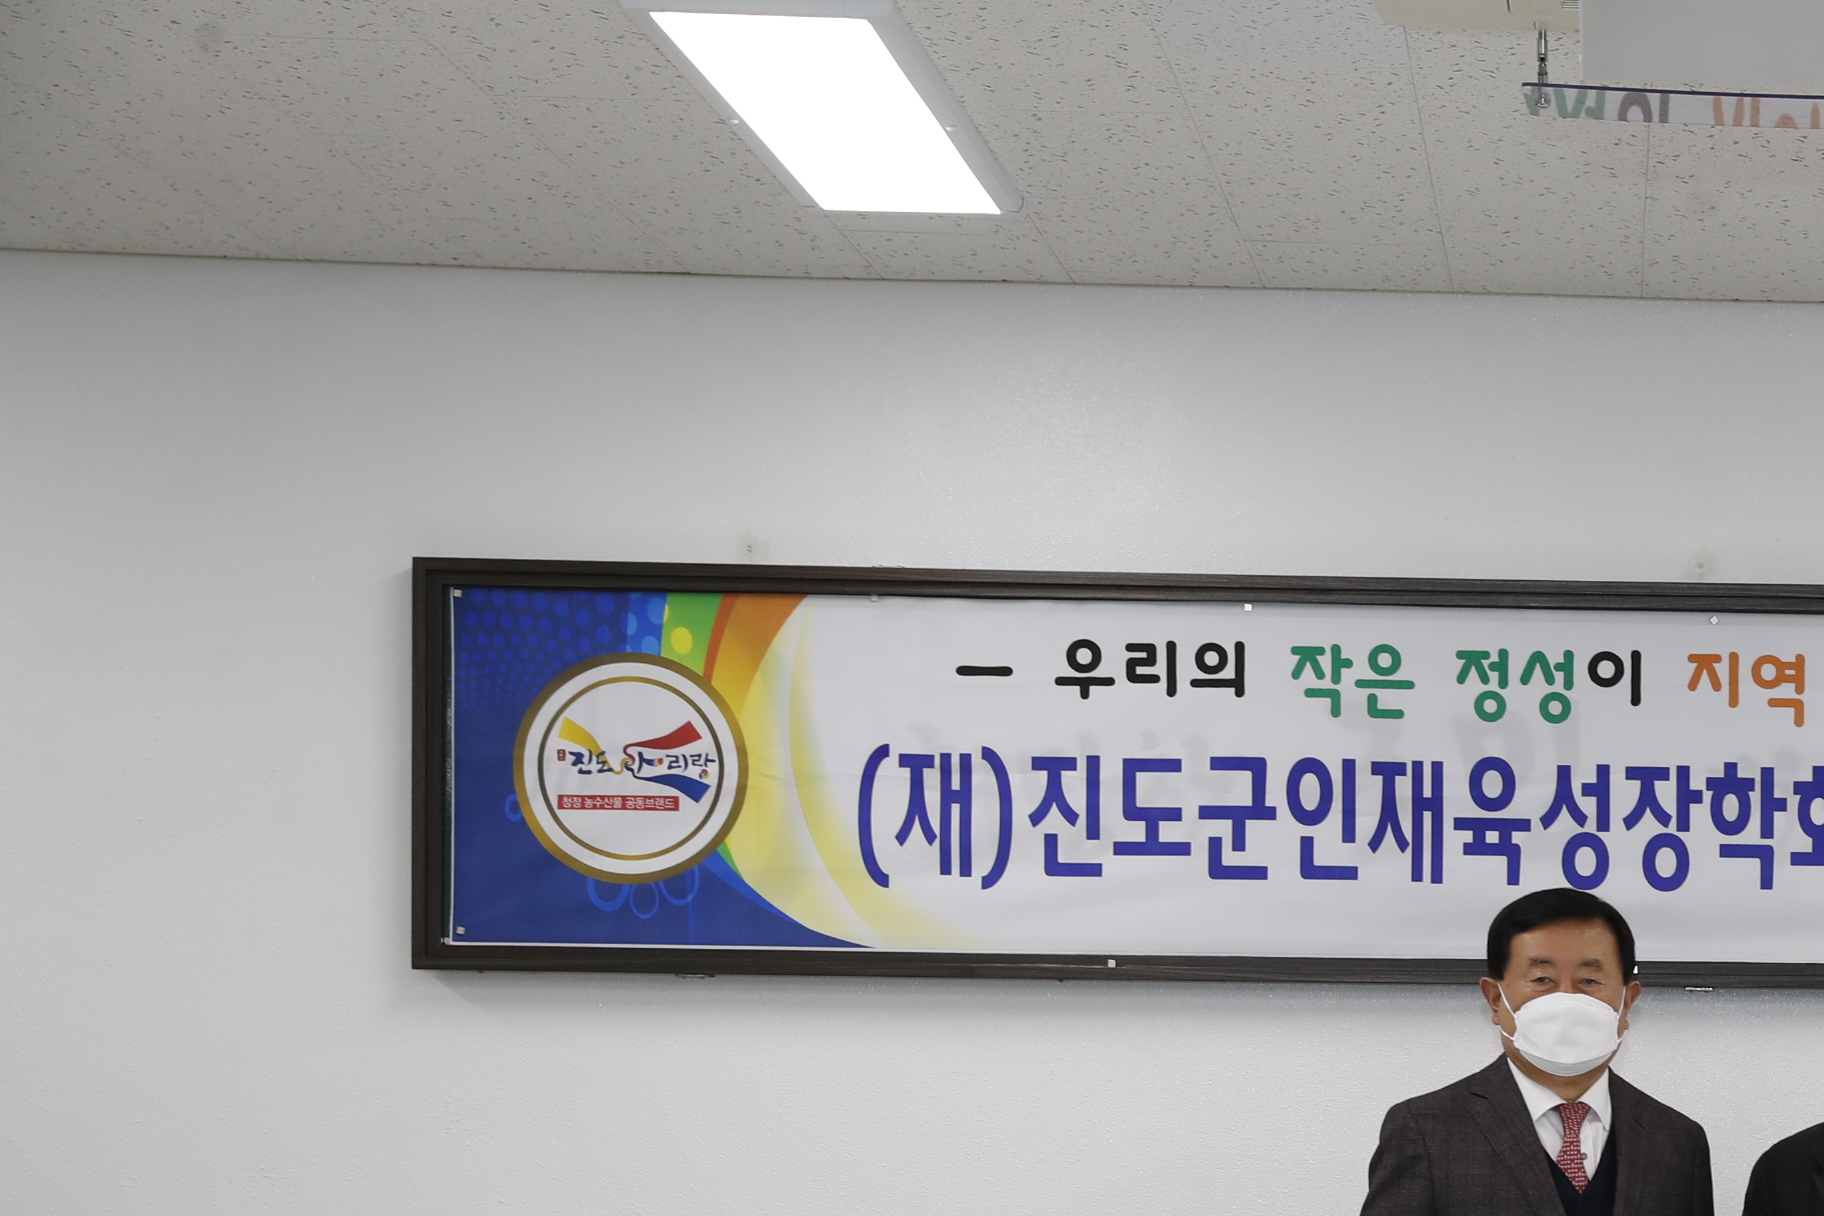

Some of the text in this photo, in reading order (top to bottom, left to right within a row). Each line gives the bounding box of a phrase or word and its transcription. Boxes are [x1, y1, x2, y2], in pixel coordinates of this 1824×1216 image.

[1053, 638, 1246, 701] 우리의
[1290, 643, 1416, 720] 작은
[1455, 647, 1642, 725] 정성이
[1687, 651, 1806, 728] 지역
[562, 796, 582, 808] 청정
[625, 797, 675, 809] 공동브랜드
